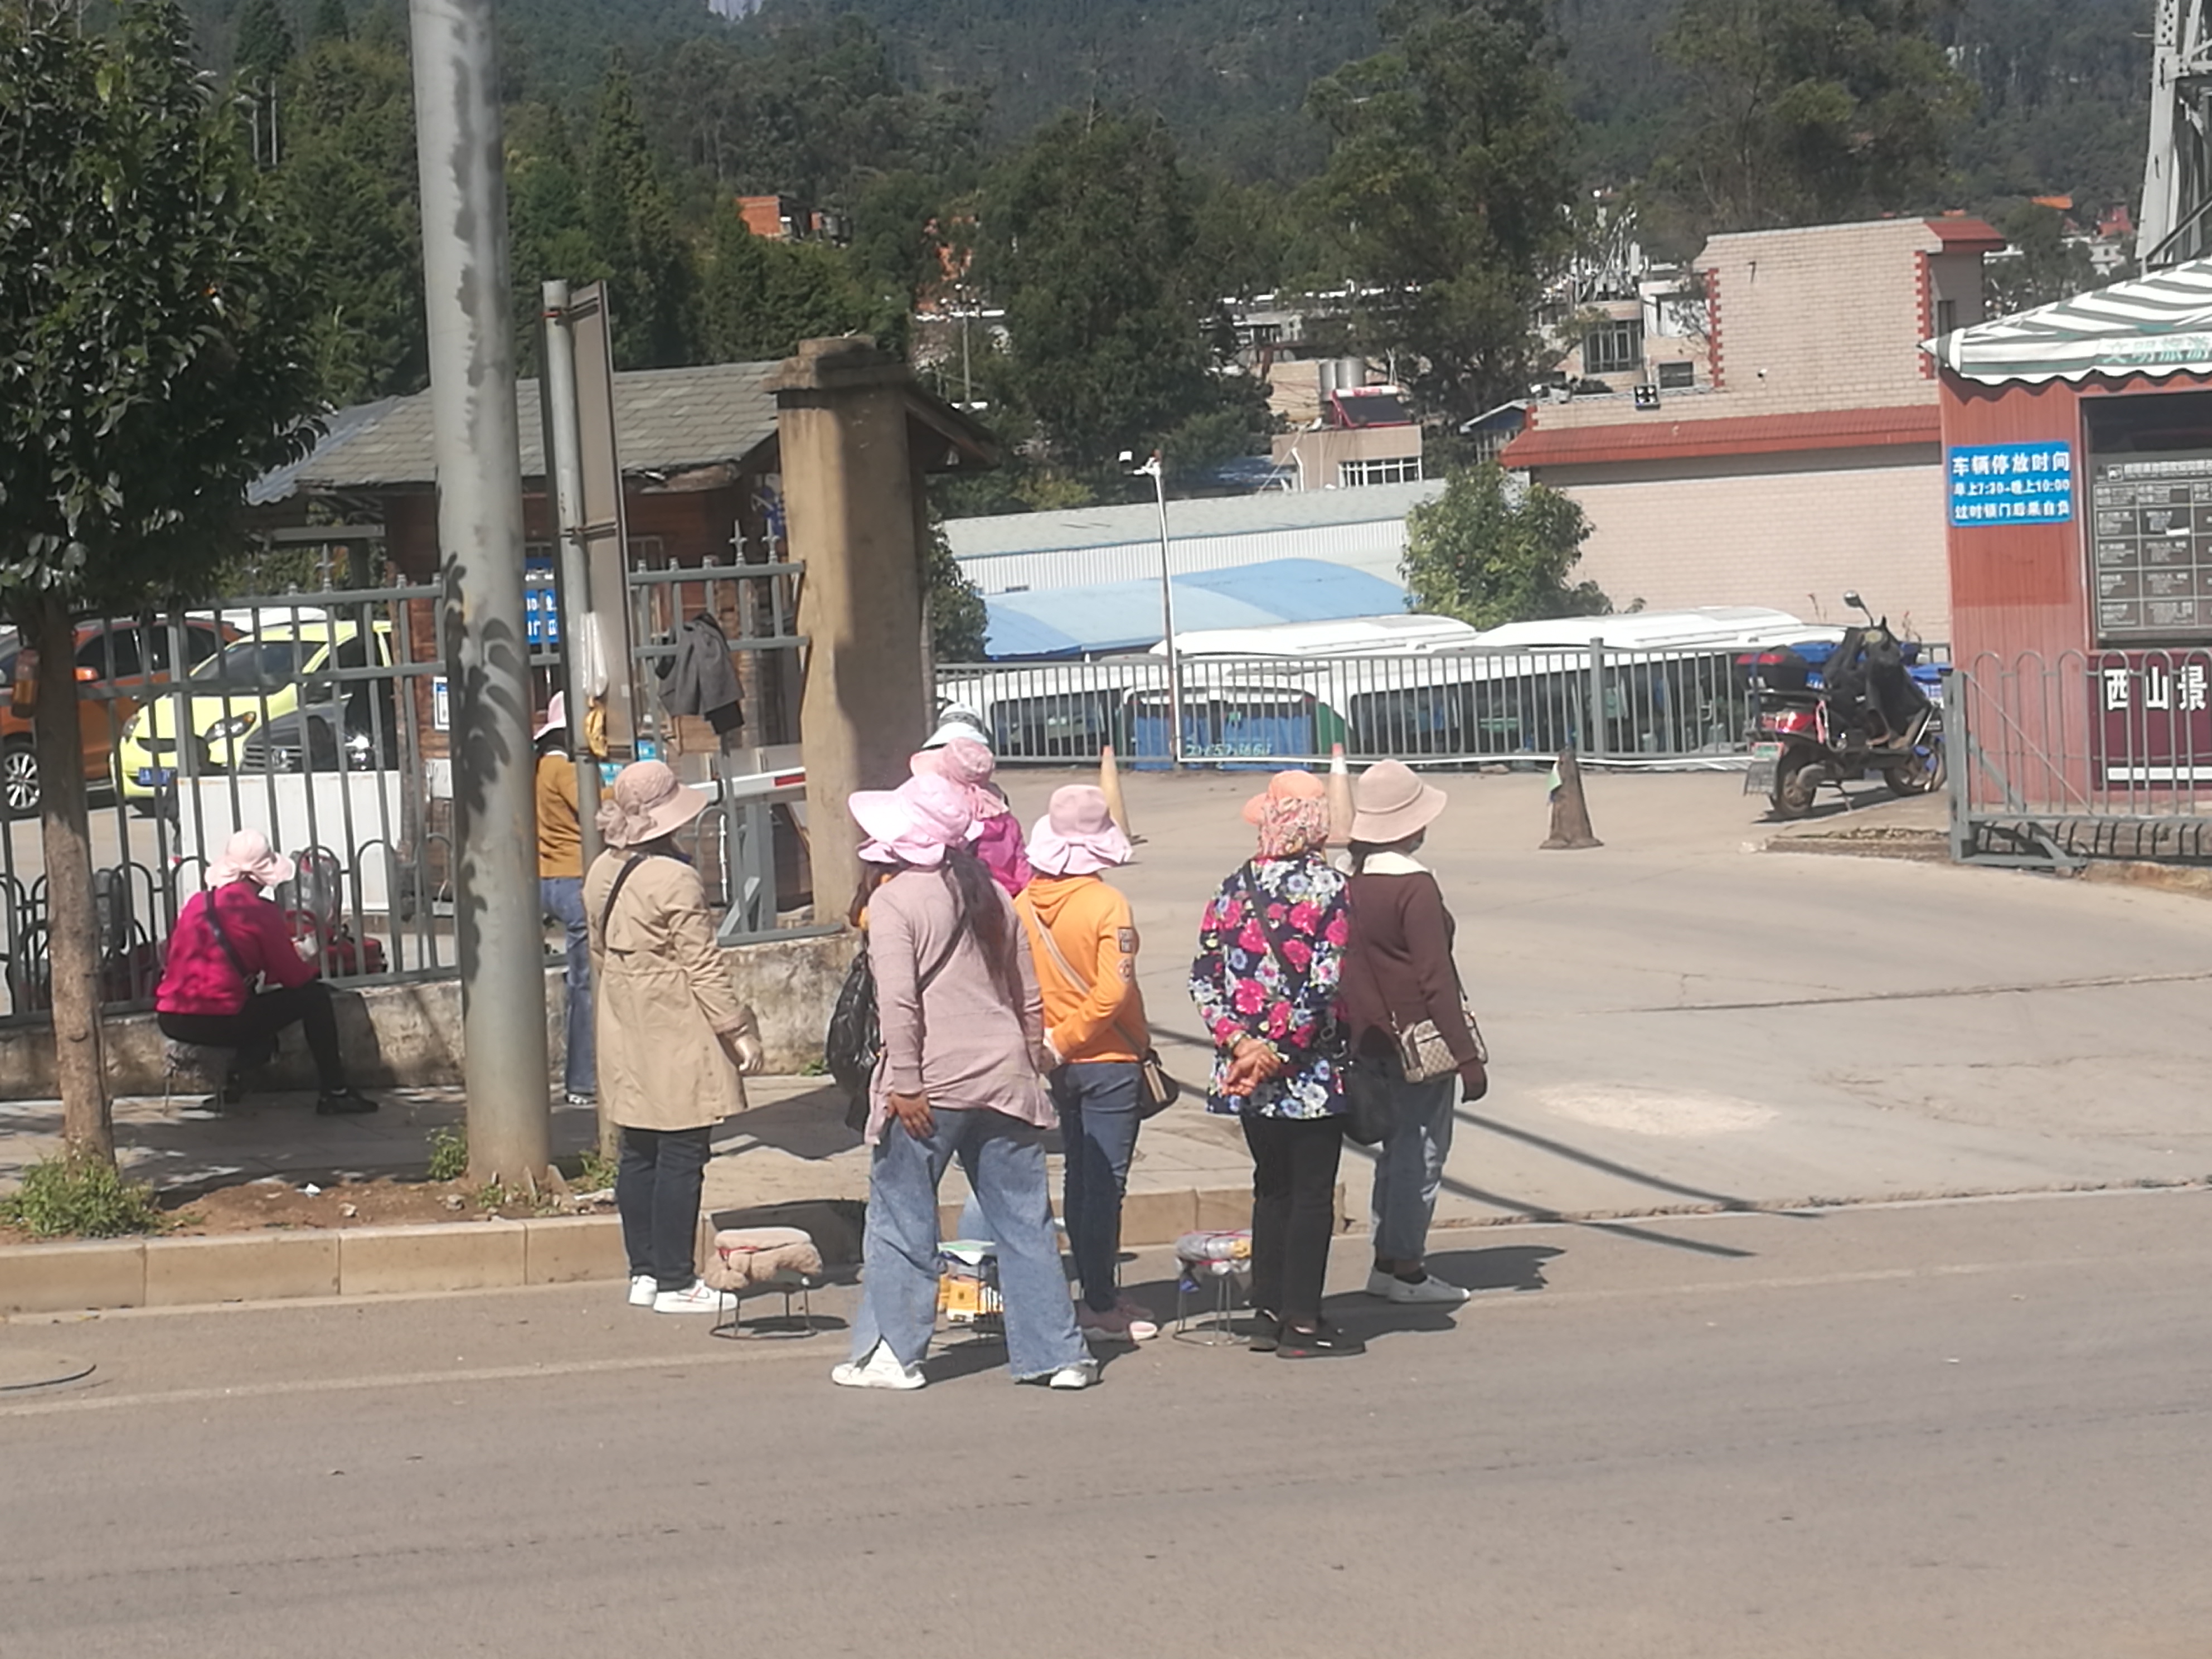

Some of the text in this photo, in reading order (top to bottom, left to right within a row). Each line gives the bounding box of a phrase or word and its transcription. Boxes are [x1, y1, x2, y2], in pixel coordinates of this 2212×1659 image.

[1952, 451, 2069, 477] 车辆停放时间
[2104, 666, 2208, 710] 西山景
